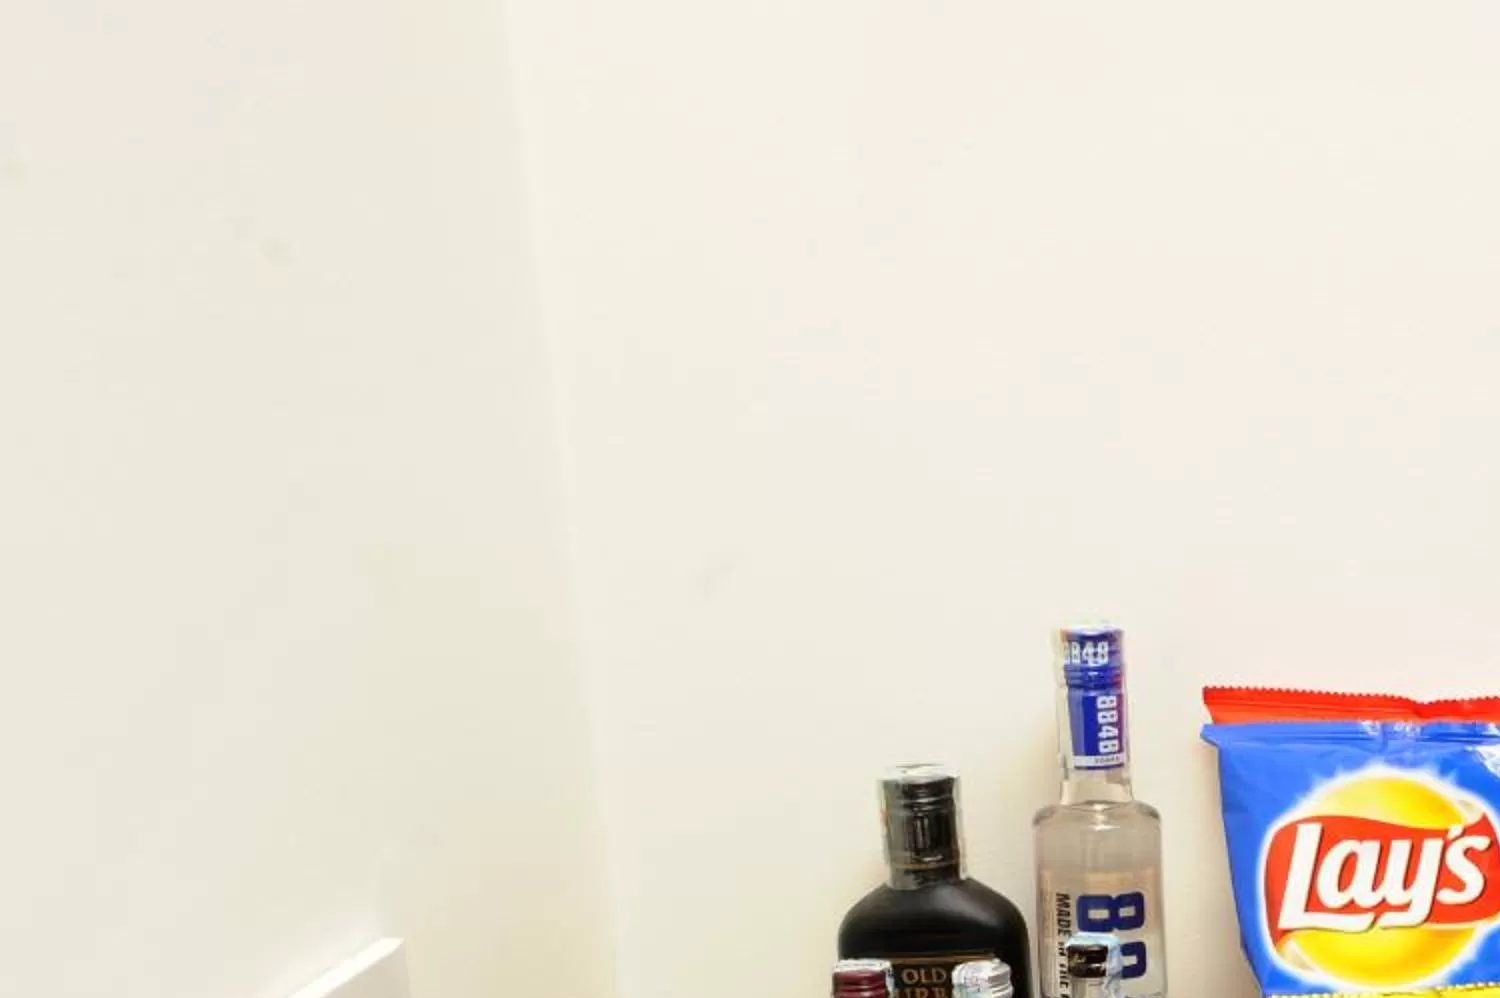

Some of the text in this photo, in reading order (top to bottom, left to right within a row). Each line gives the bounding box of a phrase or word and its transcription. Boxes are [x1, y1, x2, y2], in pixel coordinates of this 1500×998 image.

[1096, 695, 1119, 754] 8848
[1277, 822, 1492, 933] Lay's
[1056, 893, 1072, 937] MADE
[902, 968, 947, 984] OLD
